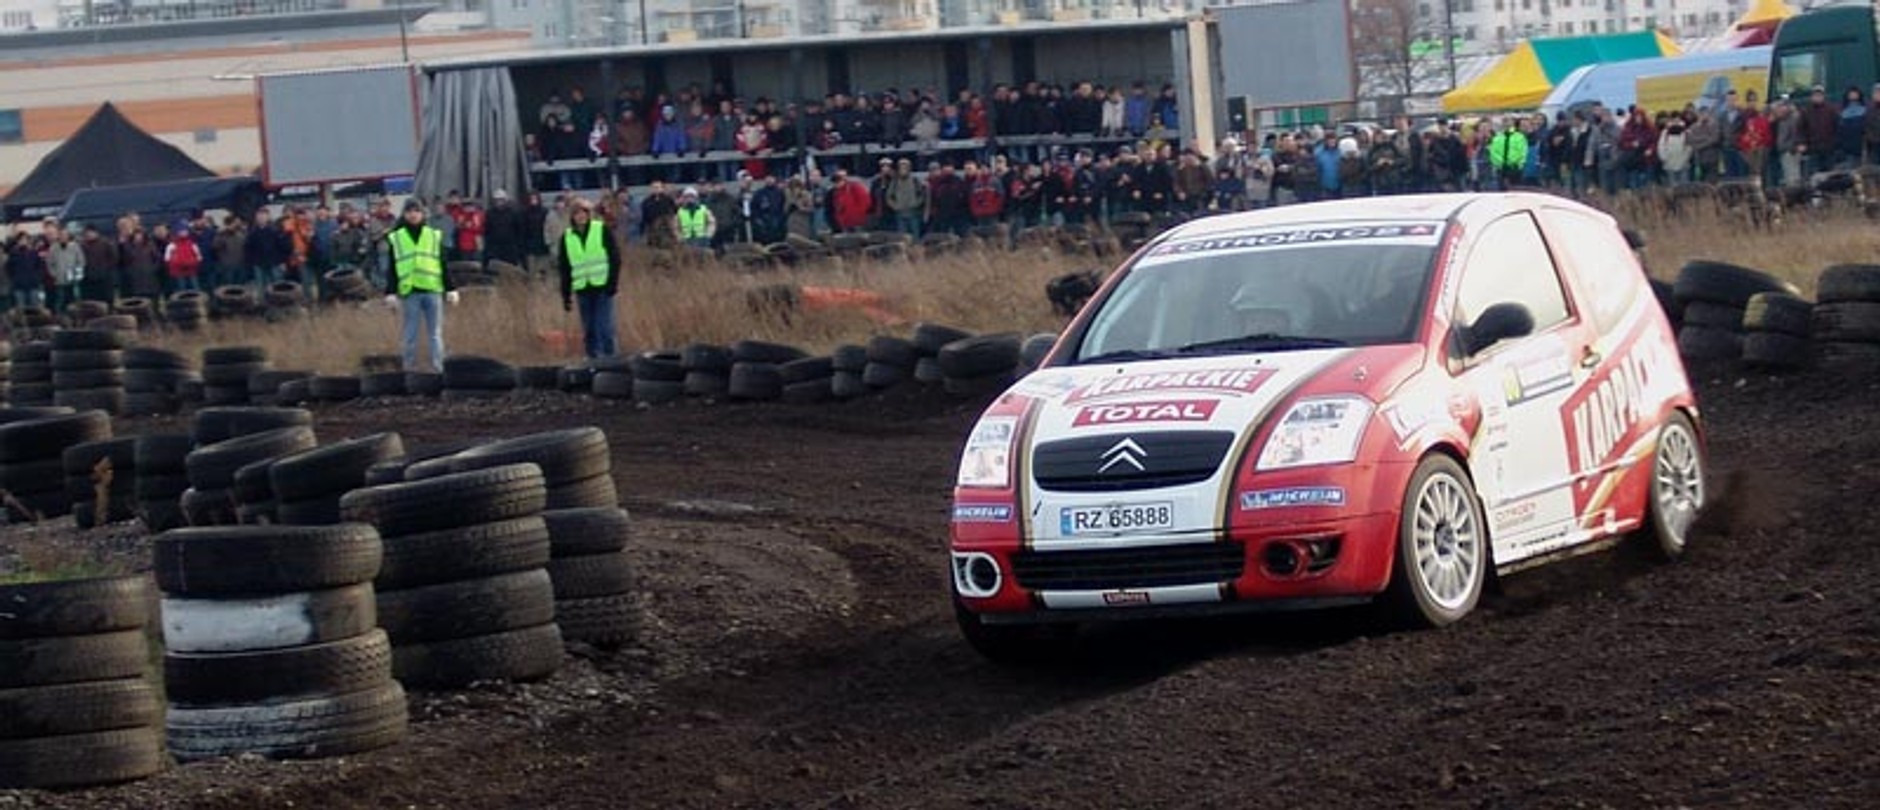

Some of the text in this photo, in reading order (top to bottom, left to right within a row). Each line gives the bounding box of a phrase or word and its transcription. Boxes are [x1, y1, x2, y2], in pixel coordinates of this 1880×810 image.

[1080, 370, 1255, 398] KARPACKIE
[1087, 403, 1206, 422] TOTAL
[1075, 507, 1169, 529] RZ 65888
